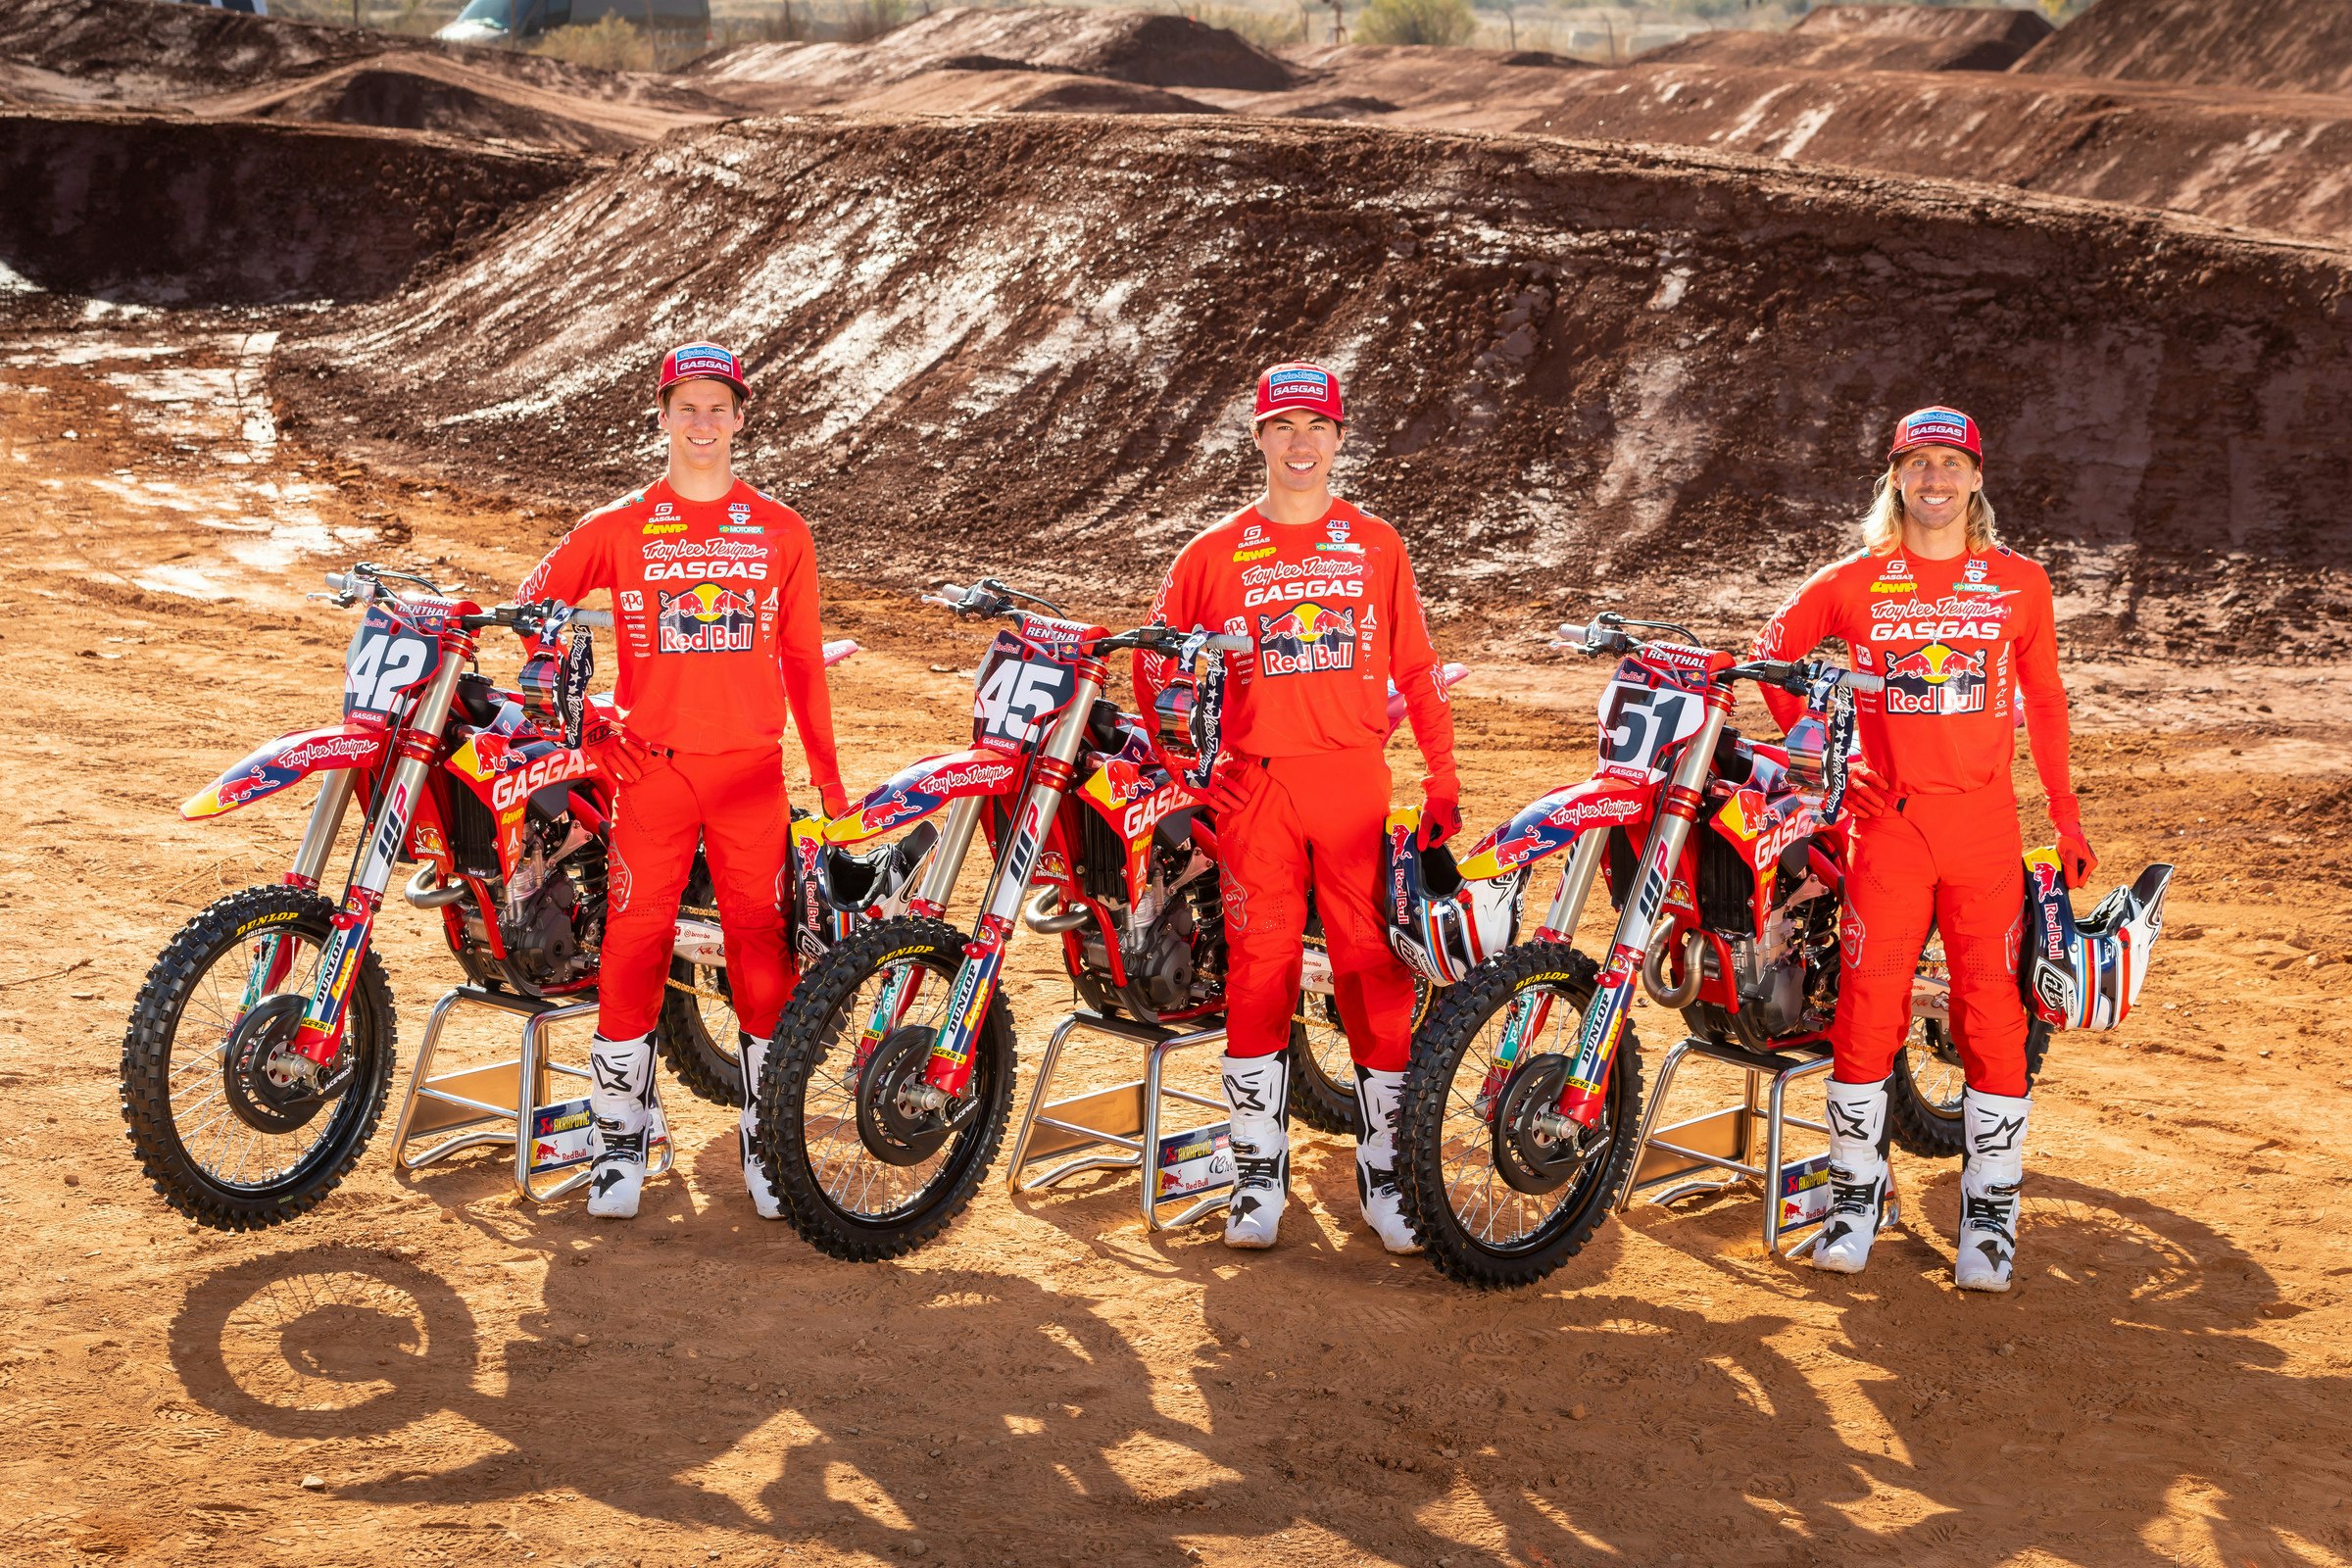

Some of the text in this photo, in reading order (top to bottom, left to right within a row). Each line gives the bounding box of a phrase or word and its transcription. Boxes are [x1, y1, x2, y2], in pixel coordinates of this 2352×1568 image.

[680, 361, 729, 372] GASGAS
[1274, 385, 1324, 396] GASGAS
[1910, 425, 1962, 437] GASGAS
[643, 523, 688, 535] 4WP
[1329, 520, 1349, 529] AMA
[643, 537, 768, 562] Troy Lee Designs
[1238, 537, 1271, 549] GASGAS
[1233, 547, 1277, 563] 4WP
[1968, 560, 1987, 569] AMA
[644, 561, 768, 581] GASGAS
[1242, 556, 1363, 586] Troy Lee Designs
[1245, 580, 1363, 608] GASGAS
[1870, 581, 1918, 593] 4WP
[621, 593, 643, 609] PPG
[1871, 596, 2003, 621] Troy Lee Designs
[661, 623, 753, 651] Red Bull
[1225, 619, 1247, 635] PPG
[1870, 621, 2001, 641] GASGAS
[995, 642, 1020, 655] Red Bull
[1263, 642, 1353, 675] Red Bull
[1647, 650, 1708, 668] RENTHAL
[345, 634, 427, 712] 42
[1618, 670, 1645, 683] Red Bull
[974, 659, 1064, 743] 45
[1887, 686, 1936, 712] Red
[352, 712, 382, 722] GASGAS
[1599, 685, 1688, 772] 51
[278, 737, 379, 768] Troy Lee Designs
[982, 737, 1016, 750] GASGAS
[919, 775, 949, 795] Troy
[947, 771, 968, 787] Lee
[965, 764, 1013, 788] Designs
[1609, 767, 1644, 779] GASGAS
[1549, 808, 1580, 826] Troy
[1578, 803, 1599, 819] Lee
[1597, 798, 1642, 822] Designs
[806, 881, 821, 931] Red Bull
[1395, 868, 1410, 925] Red Bull
[235, 912, 299, 937] DUNLOP
[2044, 903, 2059, 931] Red
[2047, 930, 2064, 960] Bull
[874, 946, 934, 967] DUNLOP
[317, 935, 343, 1006] DUNLOP
[1513, 972, 1570, 992] DUNLOP
[949, 964, 976, 1035] DUNLOP
[1583, 994, 1611, 1065] DUNLOP
[563, 1149, 587, 1161] Red Bull
[1185, 1177, 1209, 1192] Red Bull
[1805, 1209, 1816, 1220] Red
